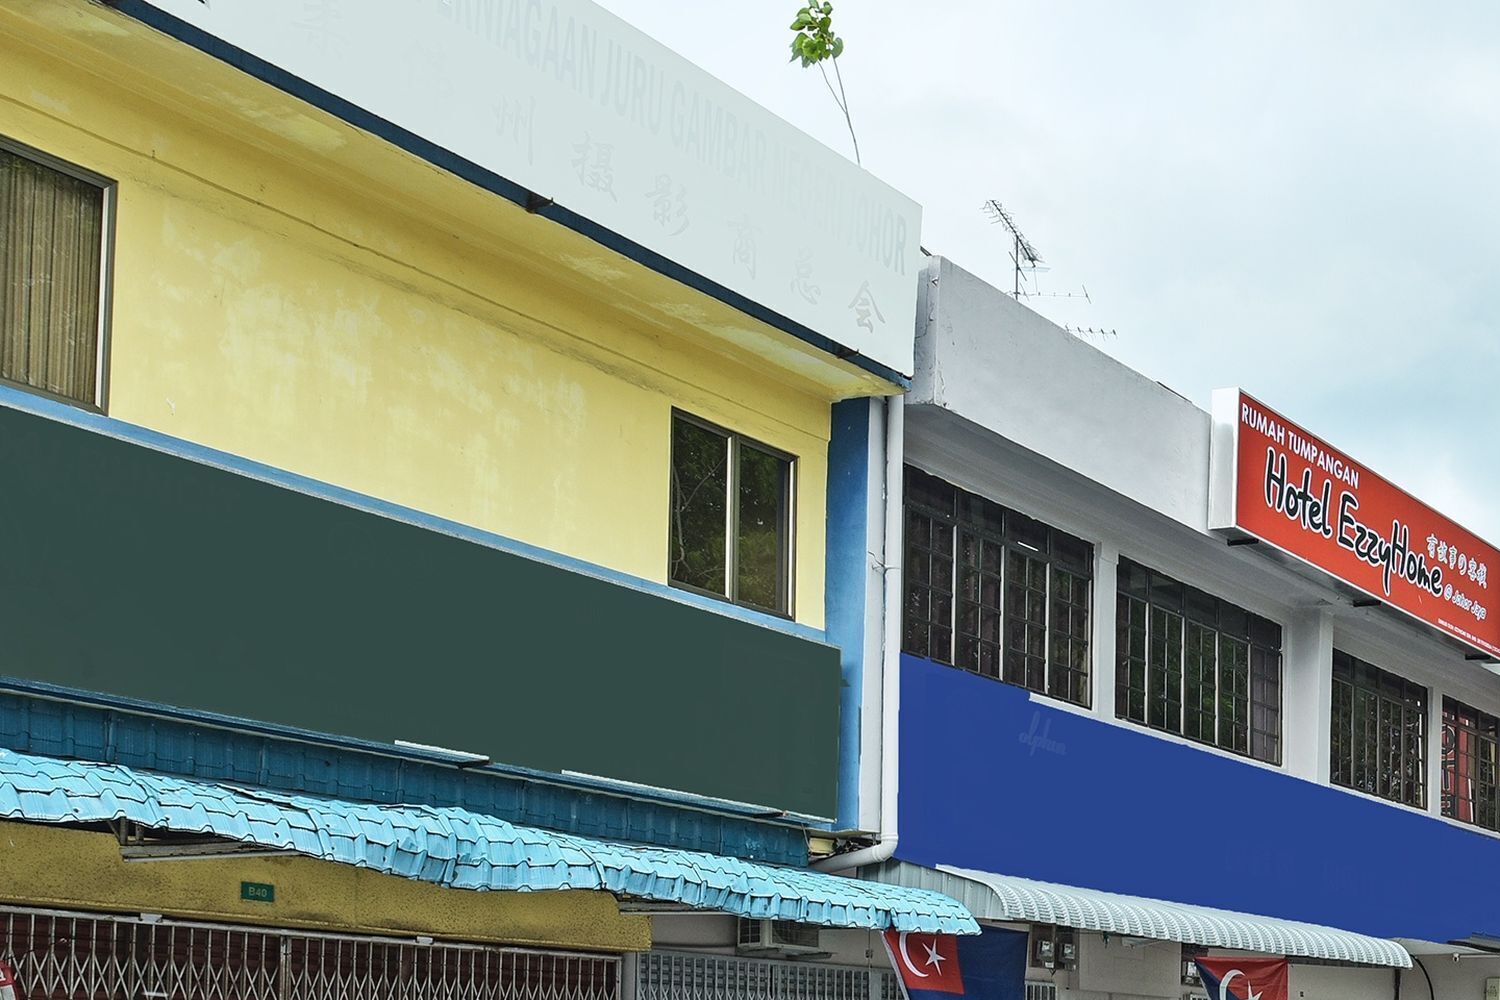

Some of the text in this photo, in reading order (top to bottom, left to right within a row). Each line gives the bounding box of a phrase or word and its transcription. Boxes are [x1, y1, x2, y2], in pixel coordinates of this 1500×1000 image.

[601, 38, 664, 136] JURU
[670, 80, 767, 196] GAMBAR
[847, 188, 907, 277] JOHOR
[1241, 403, 1359, 489] RUMAH TUMPANGAN
[1265, 447, 1443, 596] Hotel EzzyHome
